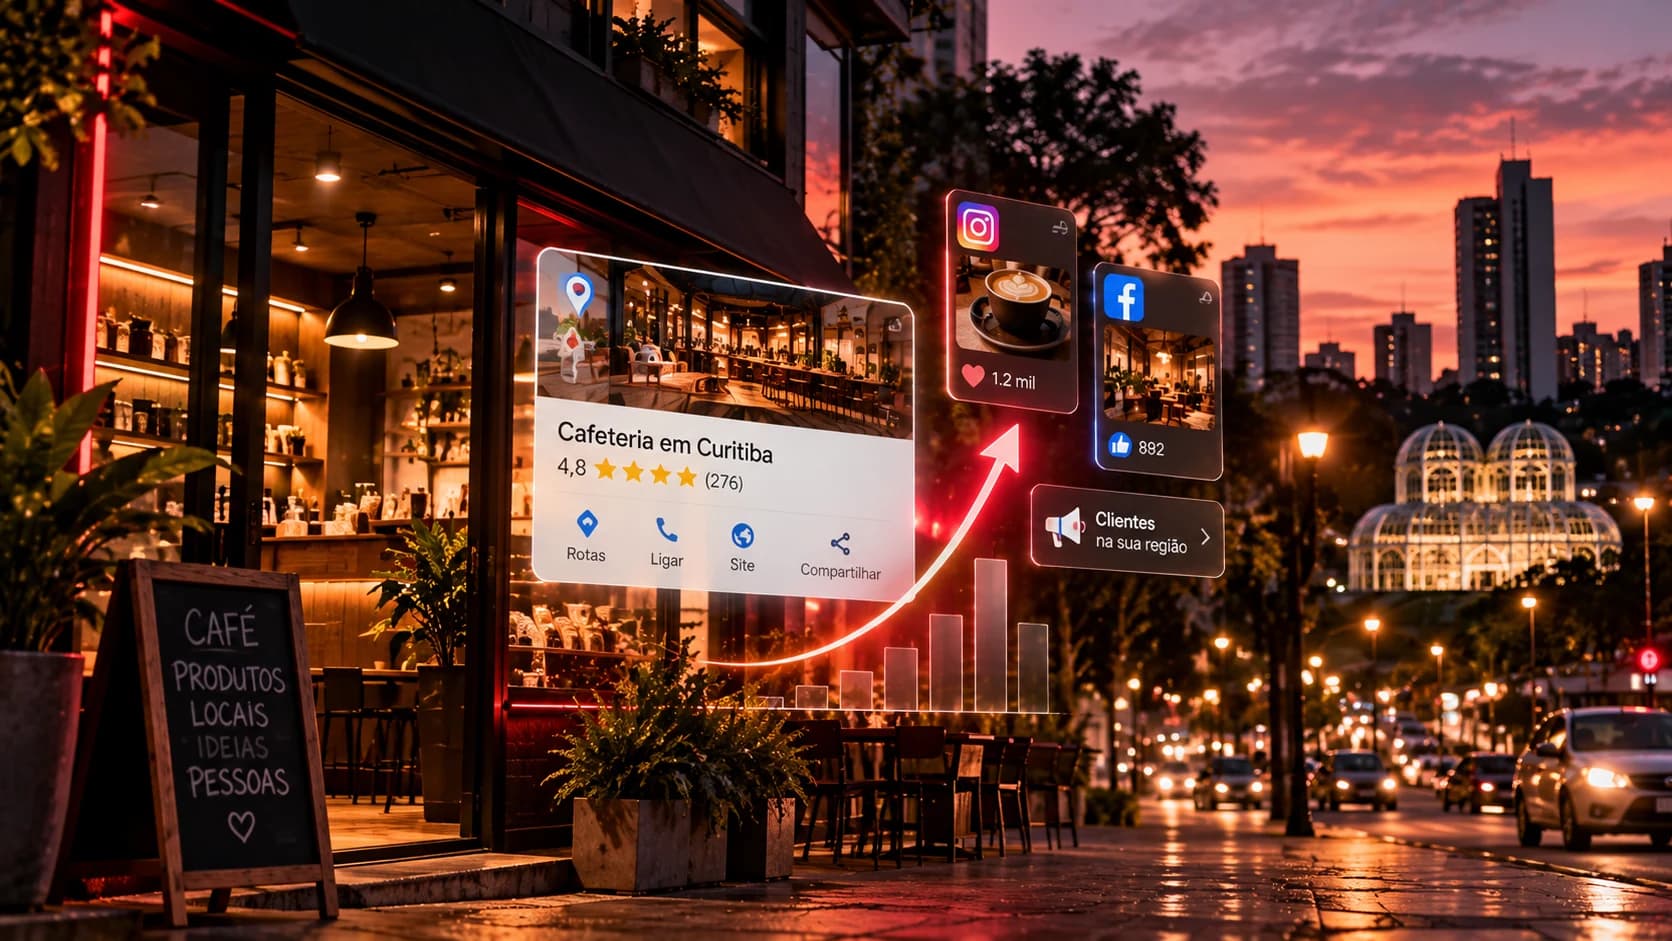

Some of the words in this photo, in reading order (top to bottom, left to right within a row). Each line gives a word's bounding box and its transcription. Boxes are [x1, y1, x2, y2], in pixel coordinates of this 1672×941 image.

[185, 603, 259, 648] CAFÉ
[172, 660, 286, 694] PRODUTOS
[197, 734, 268, 760] IDEIAS
[186, 766, 290, 800] PESSOAS
